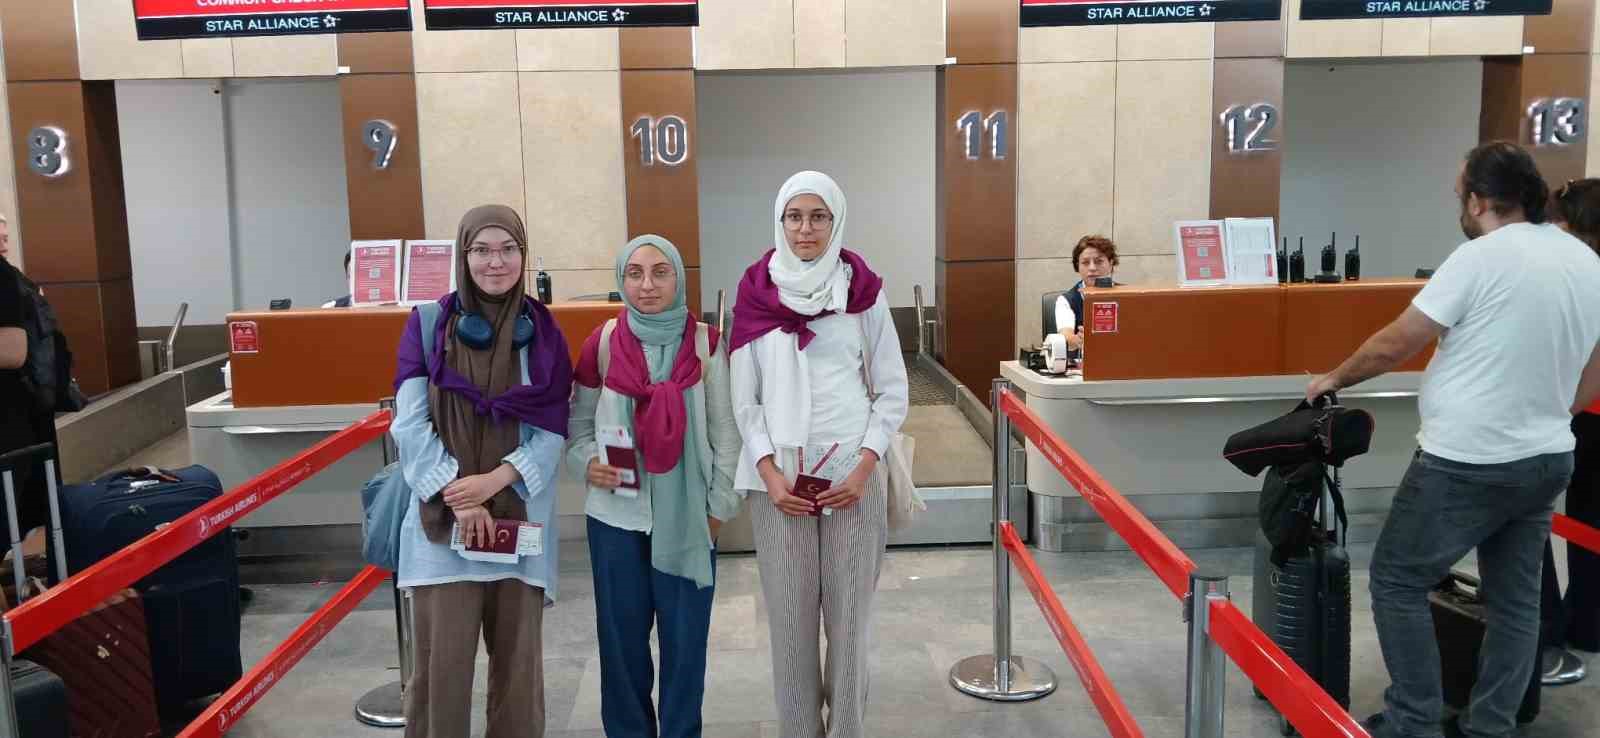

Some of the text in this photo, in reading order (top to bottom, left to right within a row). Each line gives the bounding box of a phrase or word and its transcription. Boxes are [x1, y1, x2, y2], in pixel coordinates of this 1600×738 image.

[206, 16, 320, 32] STAR ALLIANCE
[495, 9, 608, 23] STAR ALLIANCE
[1087, 5, 1195, 19] STAR ALLIANCE
[1366, 0, 1470, 13] STAR ALLIANCE
[363, 119, 398, 169] 9
[630, 115, 688, 166] 10
[956, 109, 1008, 160] 11
[1220, 103, 1279, 153] 12
[1527, 97, 1585, 145] 13
[29, 126, 69, 177] 8
